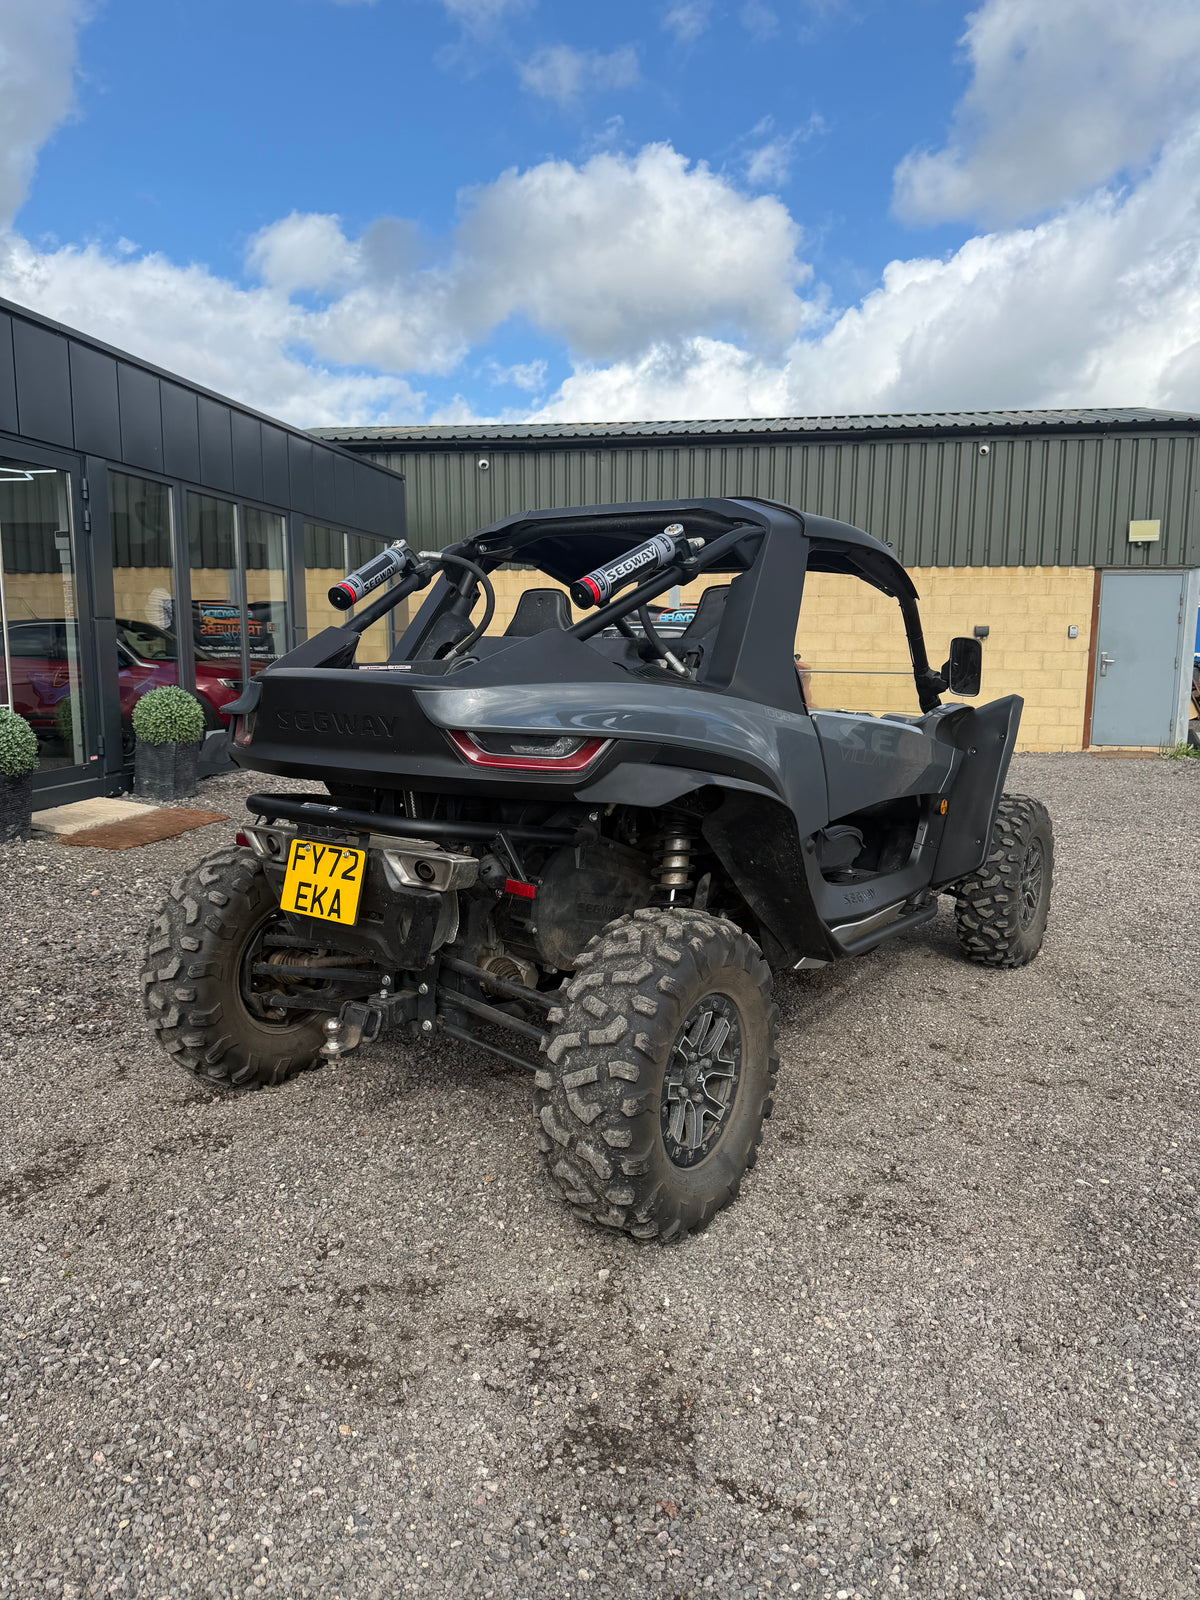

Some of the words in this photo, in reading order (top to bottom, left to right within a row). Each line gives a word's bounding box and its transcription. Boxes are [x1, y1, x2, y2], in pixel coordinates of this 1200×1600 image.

[363, 564, 397, 592] SEGWAY
[606, 546, 656, 581] SEGWAY
[275, 709, 400, 738] SEGWAY
[292, 843, 359, 881] FY72
[294, 881, 341, 919] EKA
